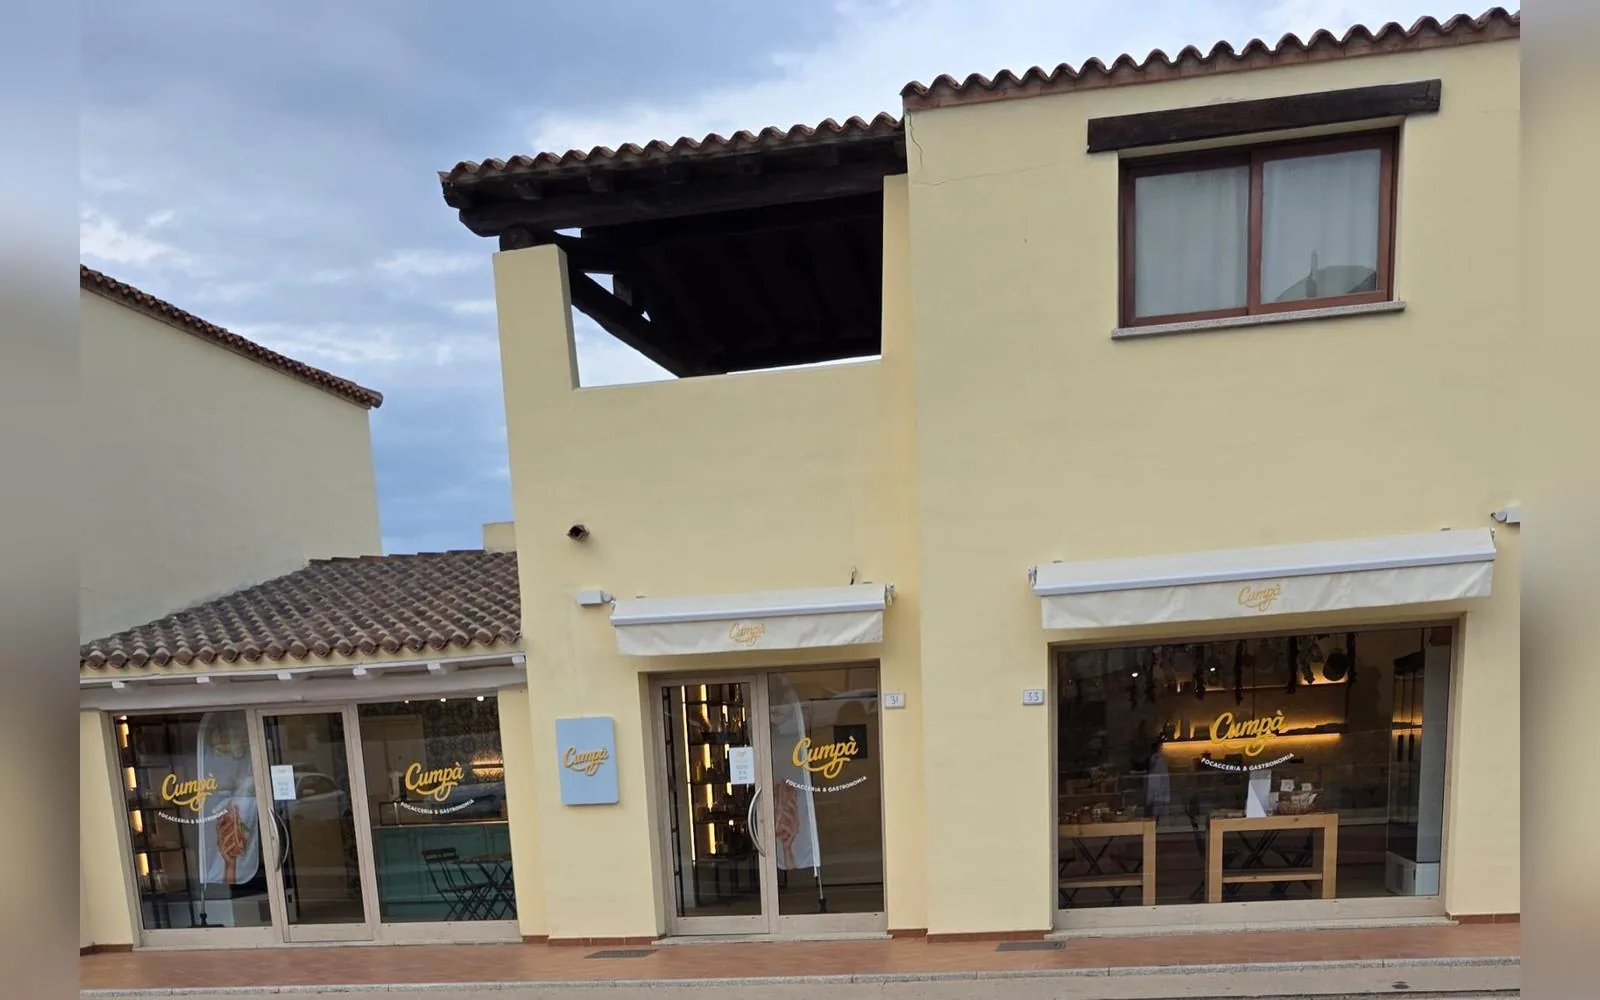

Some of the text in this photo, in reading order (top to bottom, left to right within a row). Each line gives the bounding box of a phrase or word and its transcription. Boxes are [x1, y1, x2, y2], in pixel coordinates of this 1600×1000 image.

[1028, 691, 1039, 701] 33
[1210, 710, 1285, 756] Cumpà
[792, 736, 859, 779] Cumpà
[1201, 757, 1241, 771] FOCACCERIA
[1249, 752, 1295, 771] GASTRONOMIA
[162, 773, 217, 811] Cumpà
[405, 761, 465, 802] Cumpà
[785, 778, 821, 792] FOCACCERIA
[828, 776, 867, 792] GASTRONOMIA
[400, 801, 433, 814] FOCACCERIA
[439, 798, 475, 814] GASTRONOMIA
